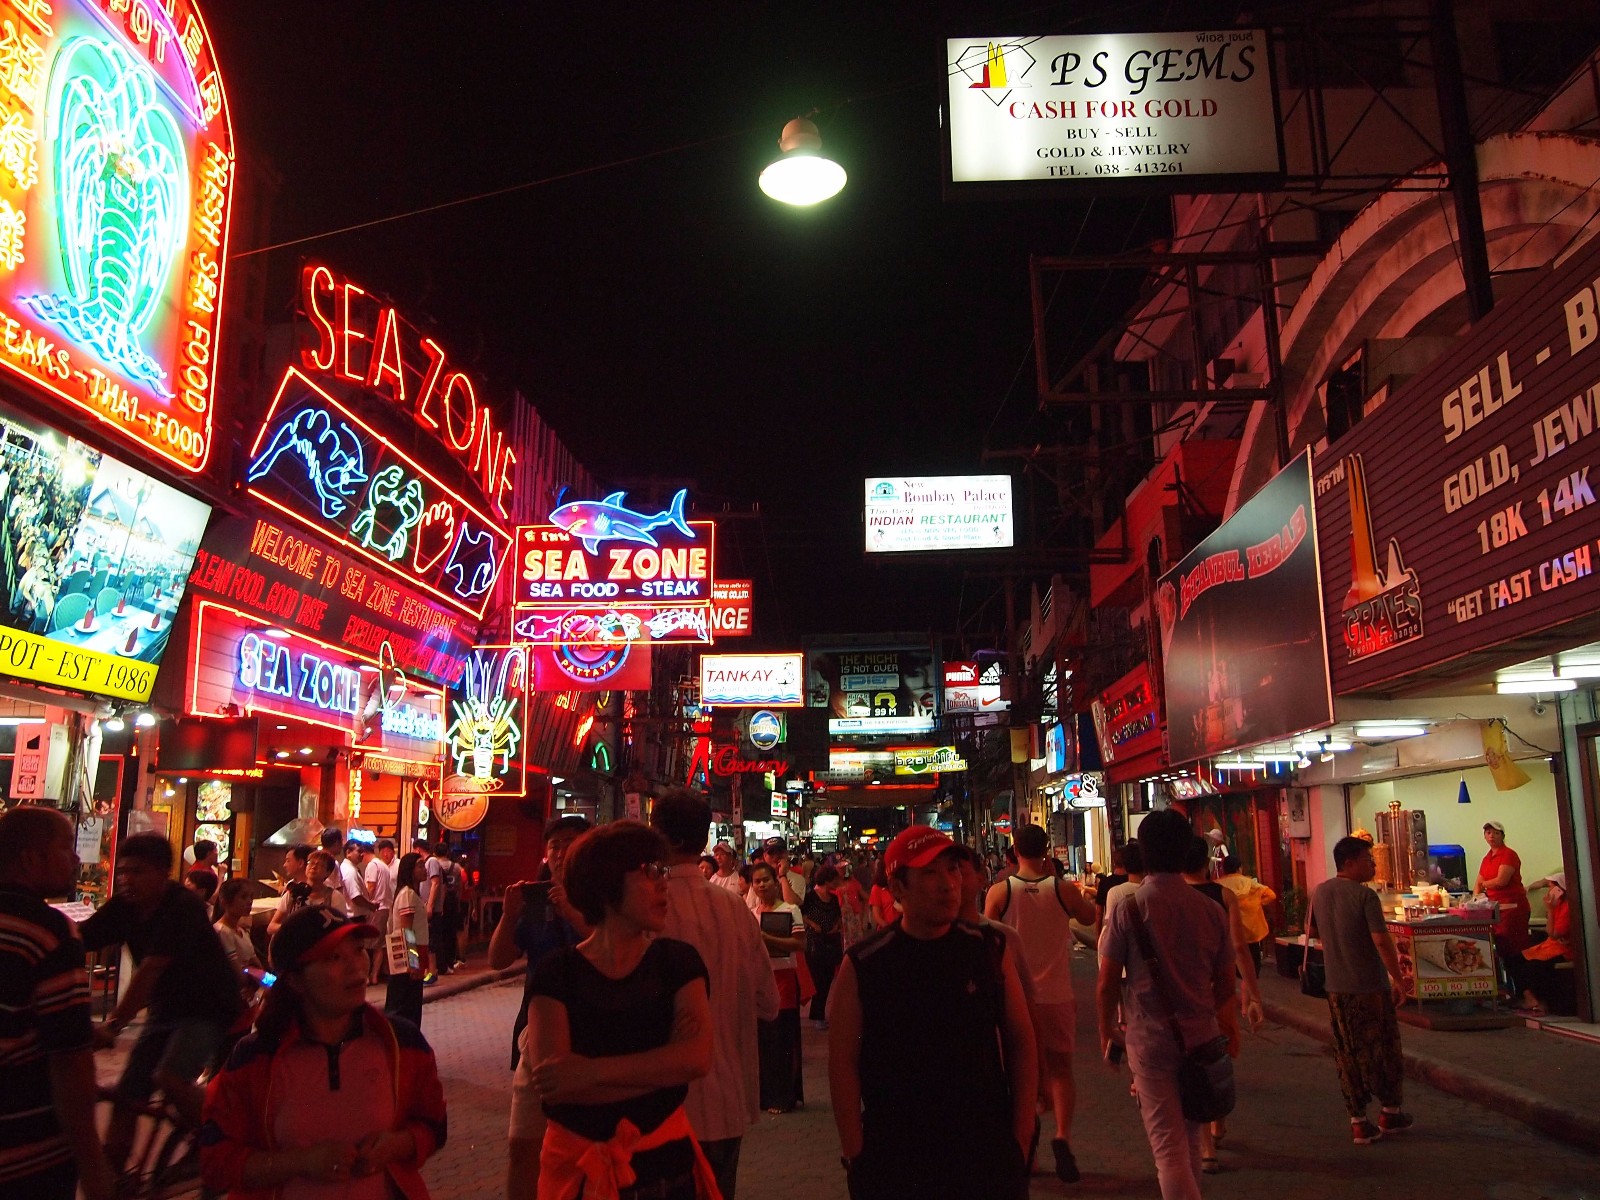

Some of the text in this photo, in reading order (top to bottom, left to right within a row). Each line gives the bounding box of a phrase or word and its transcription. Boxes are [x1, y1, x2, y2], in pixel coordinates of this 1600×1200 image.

[1124, 44, 1256, 95] GEMS
[1009, 98, 1218, 119] CASH FOR GOLD
[1066, 128, 1100, 140] BUY
[1115, 126, 1157, 138] SELL
[1037, 143, 1190, 158] GOLD & JEWELRY
[1095, 164, 1119, 175] 038
[1134, 162, 1184, 174] 413261
[186, 142, 229, 413] FRESH SEA FOOD
[1442, 350, 1523, 443] SELL
[1564, 277, 1600, 357] B
[303, 266, 517, 520] SEA ZONE
[90, 368, 139, 422] THAI
[152, 411, 205, 458] FOOD
[904, 481, 924, 489] New
[1443, 444, 1521, 514] GOLD,
[904, 489, 1007, 505] Bombay Palace
[869, 514, 1007, 526] INDIAN RESTAURANT
[1477, 466, 1597, 555] 18K 14K
[1246, 504, 1307, 579] KEBAB
[523, 547, 707, 581] SEA ZONE
[250, 519, 458, 643] WELCOME TO SEA ZONE RESTAURANT
[1489, 570, 1532, 609] FAST
[1539, 544, 1592, 592] CASH
[530, 583, 563, 597] SEA
[571, 582, 619, 597] FOOD
[642, 581, 699, 596] STEAK
[296, 593, 328, 631] TASTE
[1348, 624, 1418, 658] Jewelry Exchange
[560, 658, 616, 677] PATTAYA
[839, 653, 899, 665] THE NIGHT
[841, 664, 899, 674] IS NOT OVER
[103, 662, 151, 695] 1986
[240, 632, 361, 715] SEA ZONE
[707, 669, 773, 683] TANKAY
[946, 671, 973, 682] PUMA
[874, 708, 897, 716] 99 M
[947, 698, 978, 711] LONSDALE
[441, 797, 475, 817] Export
